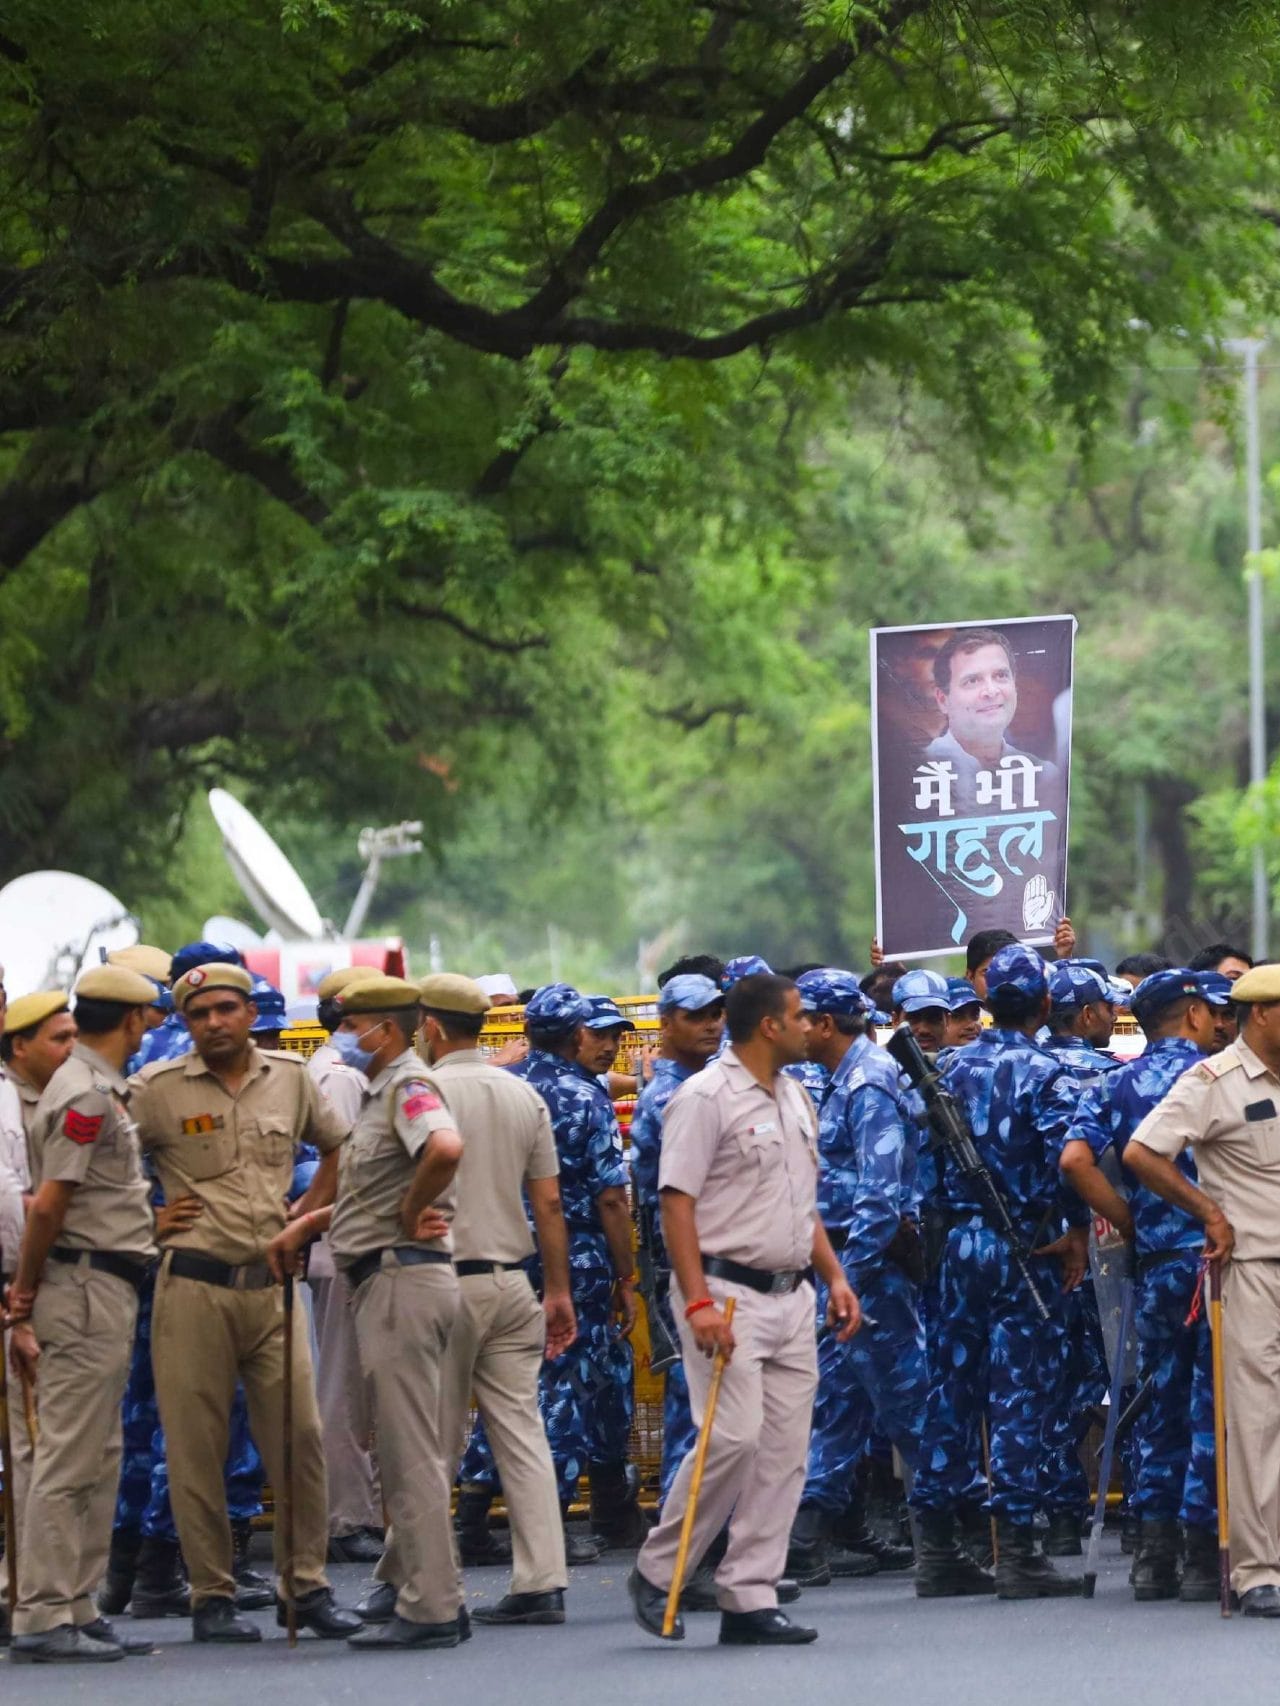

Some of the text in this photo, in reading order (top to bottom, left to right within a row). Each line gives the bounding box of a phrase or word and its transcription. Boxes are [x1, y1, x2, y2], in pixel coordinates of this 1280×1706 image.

[913, 755, 1043, 816] मैं भी
[898, 810, 1057, 944] राहुल
